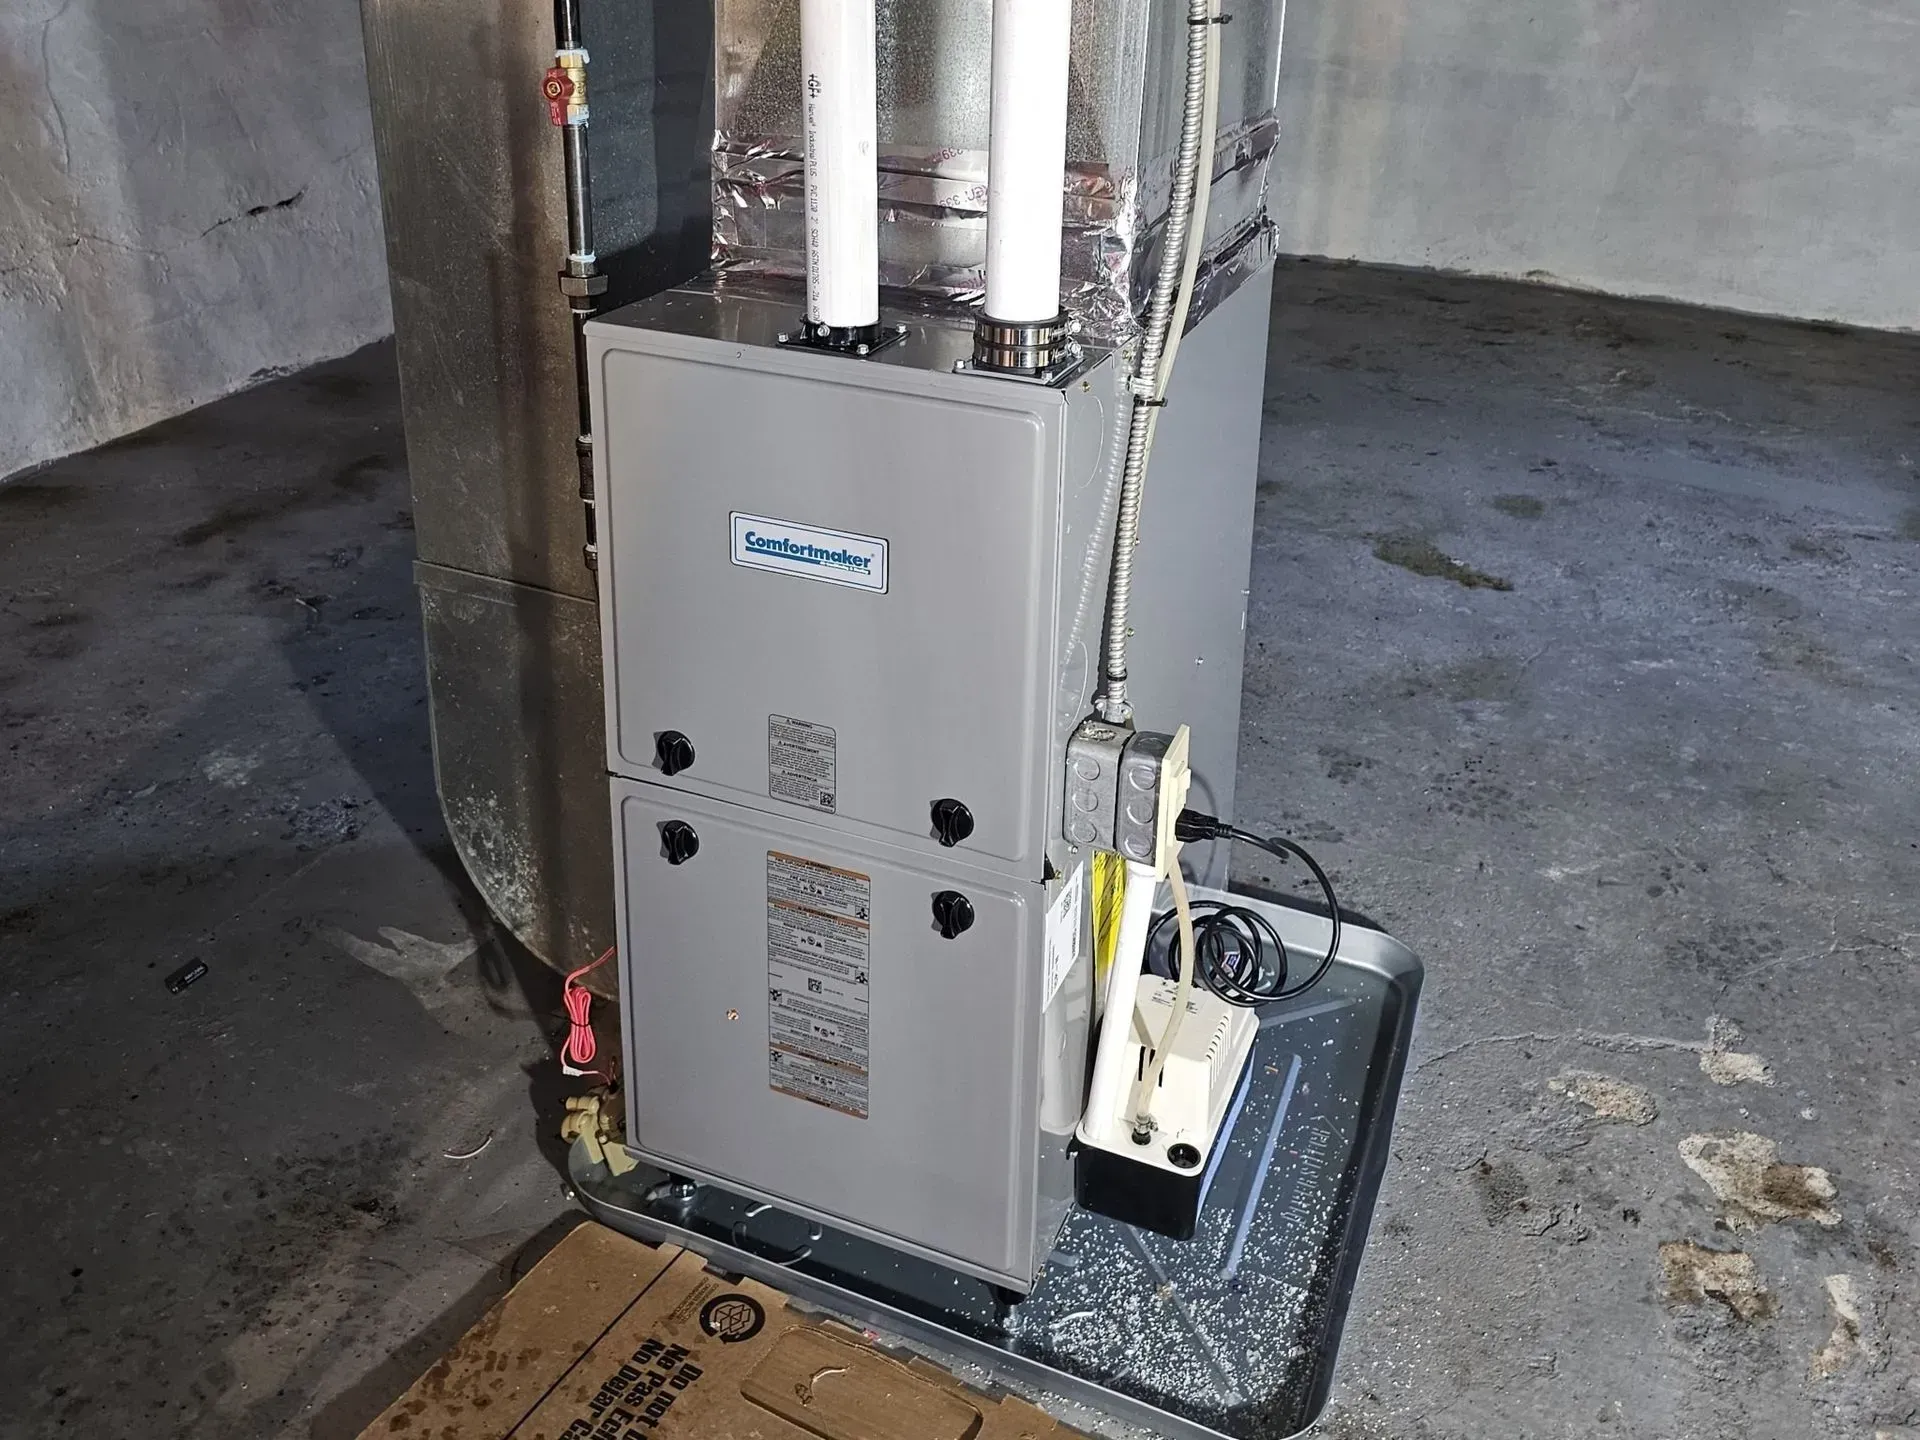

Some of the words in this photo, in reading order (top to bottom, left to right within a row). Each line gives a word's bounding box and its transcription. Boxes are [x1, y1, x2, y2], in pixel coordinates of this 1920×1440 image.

[745, 530, 871, 568] Comfortmaker
[632, 1338, 666, 1365] No
[656, 1342, 691, 1370] Ne
[588, 1364, 644, 1419] Dejar
[624, 1370, 667, 1407] Pas
[669, 1362, 704, 1390] Do
[636, 1390, 677, 1428] not
